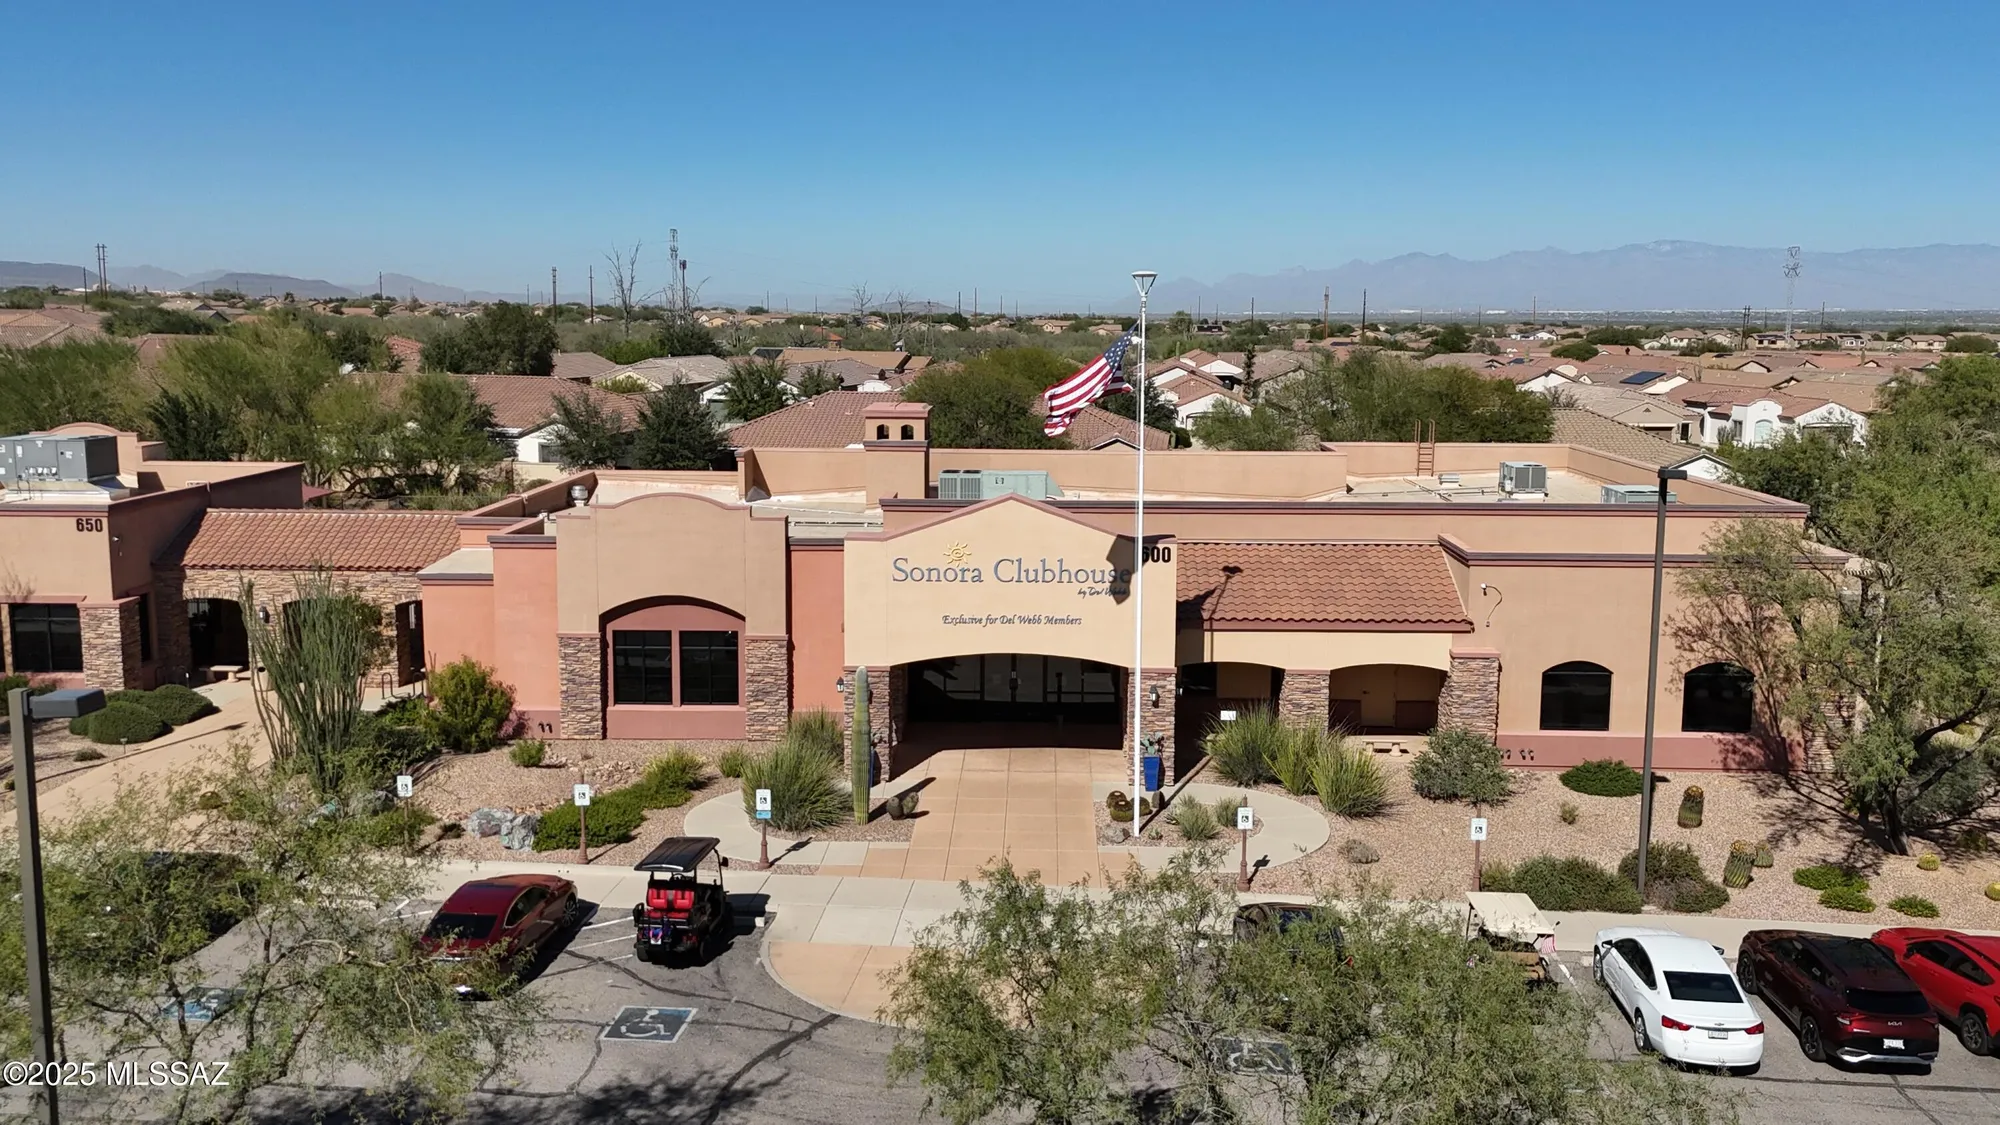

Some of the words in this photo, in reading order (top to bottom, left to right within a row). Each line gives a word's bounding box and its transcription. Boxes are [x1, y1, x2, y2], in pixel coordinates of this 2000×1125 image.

[76, 517, 103, 532] 650
[1142, 545, 1171, 563] 600
[892, 557, 984, 582] Sonora
[994, 557, 1131, 583] Clubhouse
[942, 614, 983, 626] Exclusive
[983, 614, 999, 627] for
[999, 614, 1016, 625] Del
[1017, 614, 1042, 625] Webb
[1044, 614, 1082, 625] Members
